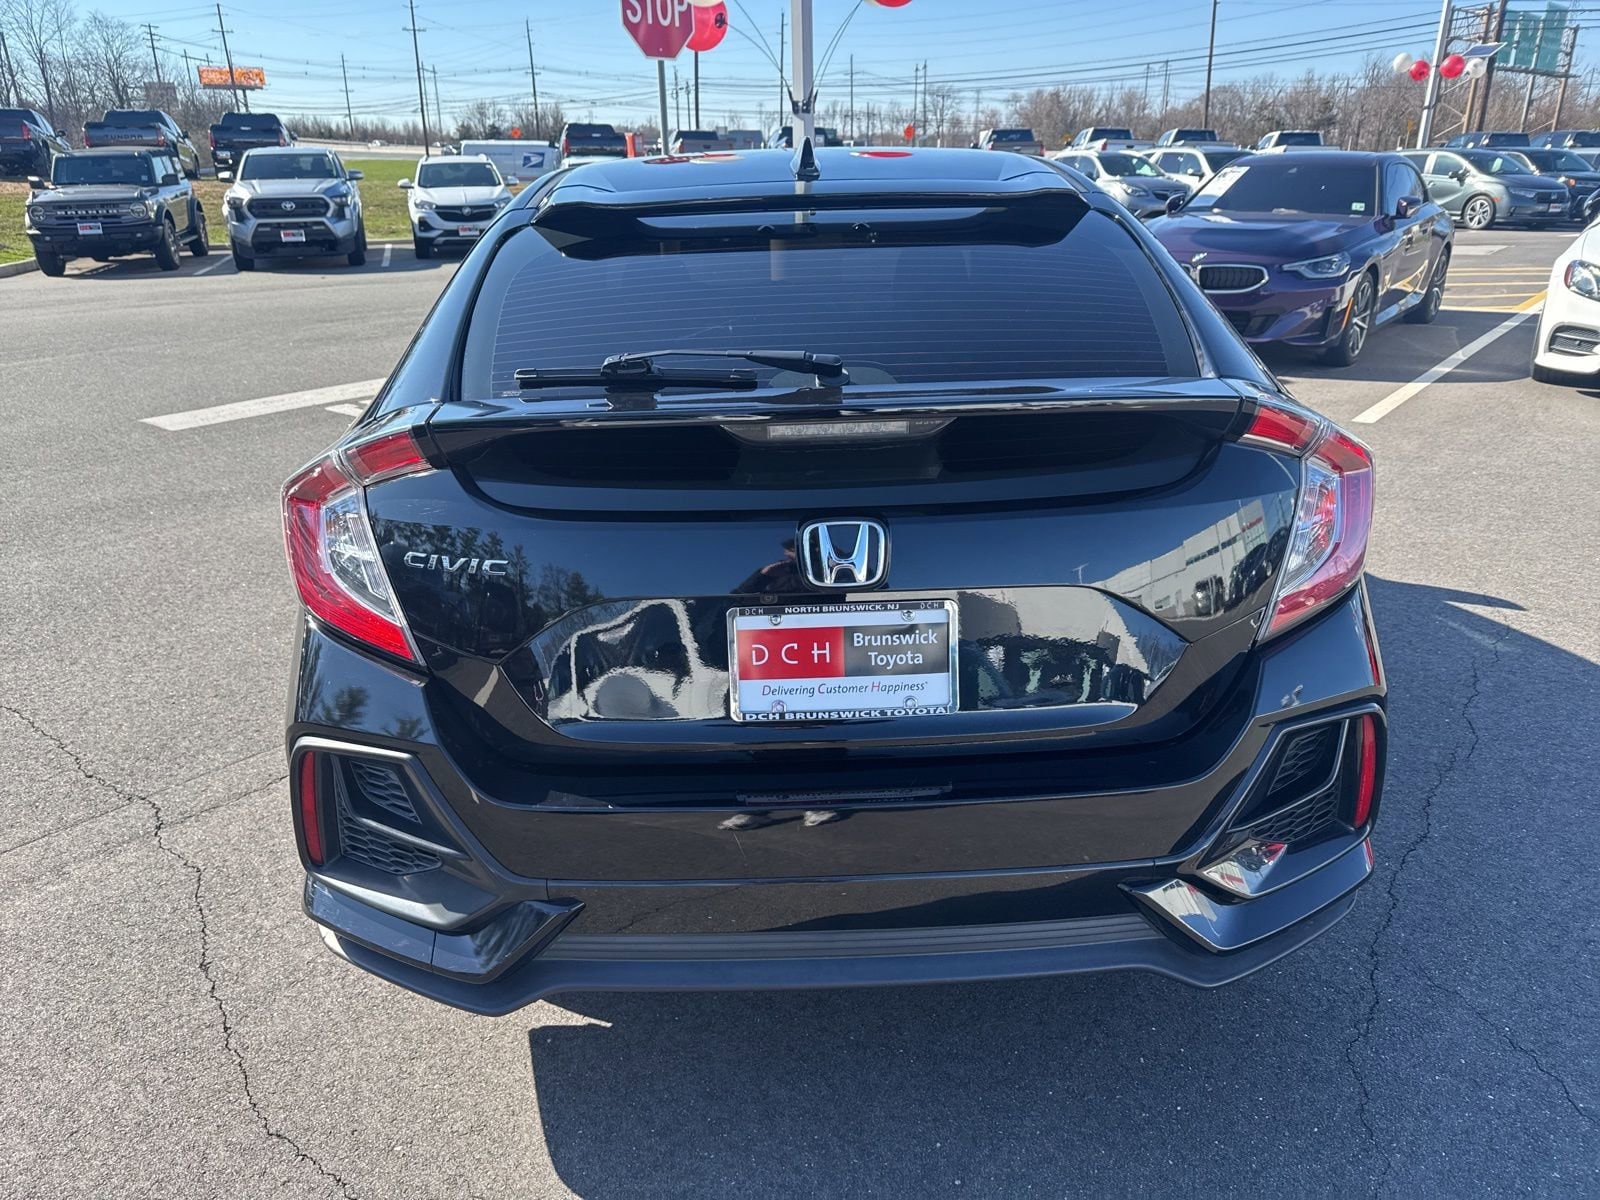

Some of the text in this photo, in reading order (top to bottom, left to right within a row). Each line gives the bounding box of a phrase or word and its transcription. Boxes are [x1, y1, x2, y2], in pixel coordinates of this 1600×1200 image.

[626, 0, 688, 27] STOP
[403, 551, 509, 576] CIVIC
[784, 606, 820, 614] NORTH
[822, 604, 885, 612] BRUNSWICK,
[853, 628, 938, 647] Brunswick
[867, 650, 923, 670] Toyota
[762, 680, 926, 697] Delivering Customer Happiness
[745, 706, 946, 721] DCH BRUNSWICK TOYOTA
